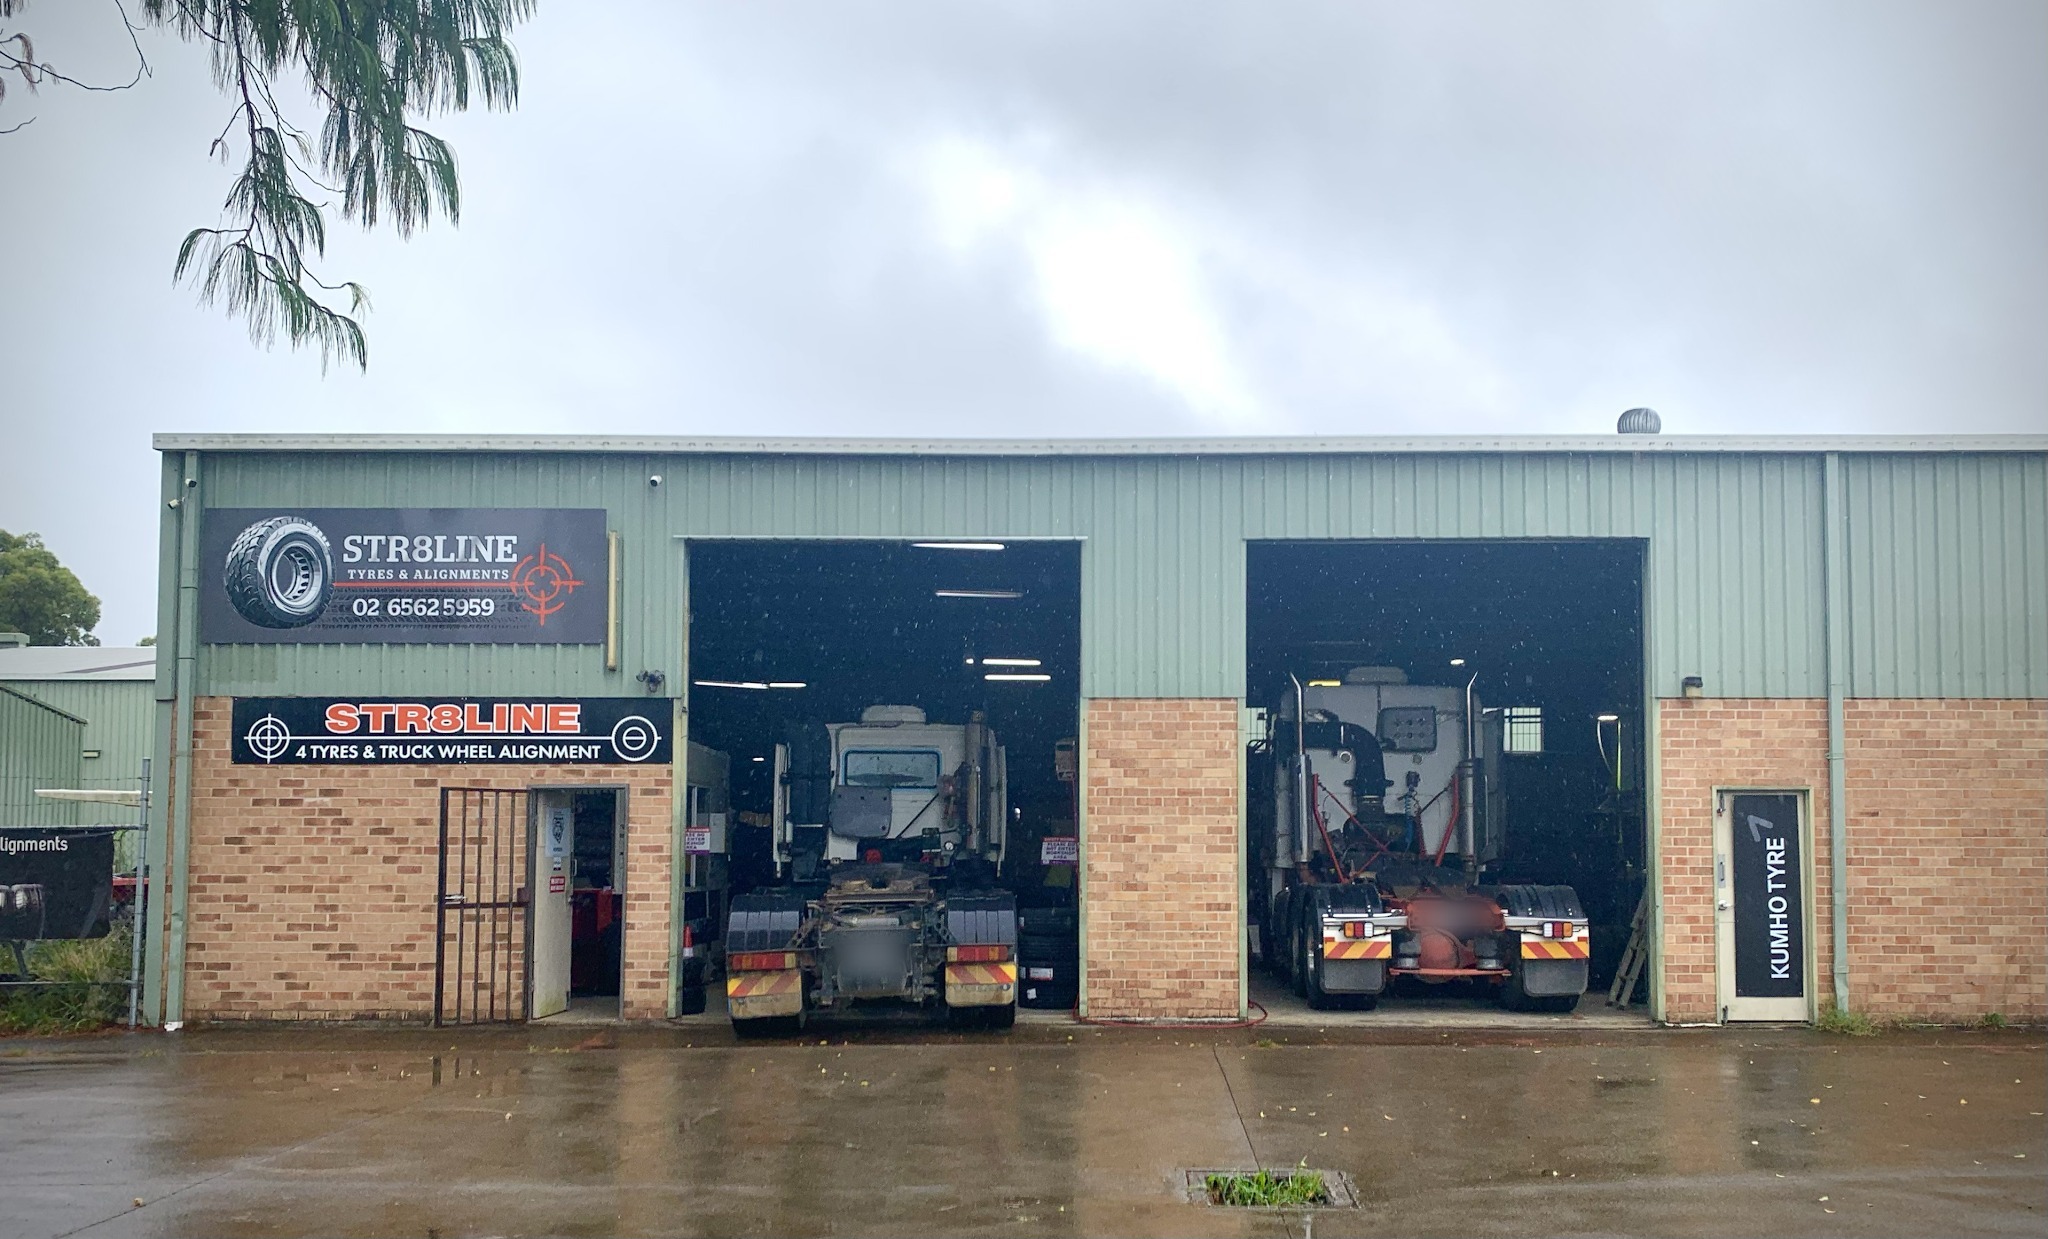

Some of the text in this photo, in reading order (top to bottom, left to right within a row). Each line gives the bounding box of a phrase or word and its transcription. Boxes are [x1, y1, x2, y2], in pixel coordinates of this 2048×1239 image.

[342, 535, 518, 563] STR8LINE
[347, 569, 509, 580] TYRES & ALIGNMENTS
[352, 598, 380, 617] 02
[325, 703, 581, 734] STR8LINE
[295, 745, 601, 759] 4 TYRES & TRUCK WHEEL ALIGNMENT
[1766, 837, 1790, 979] KUMHO TYRE
